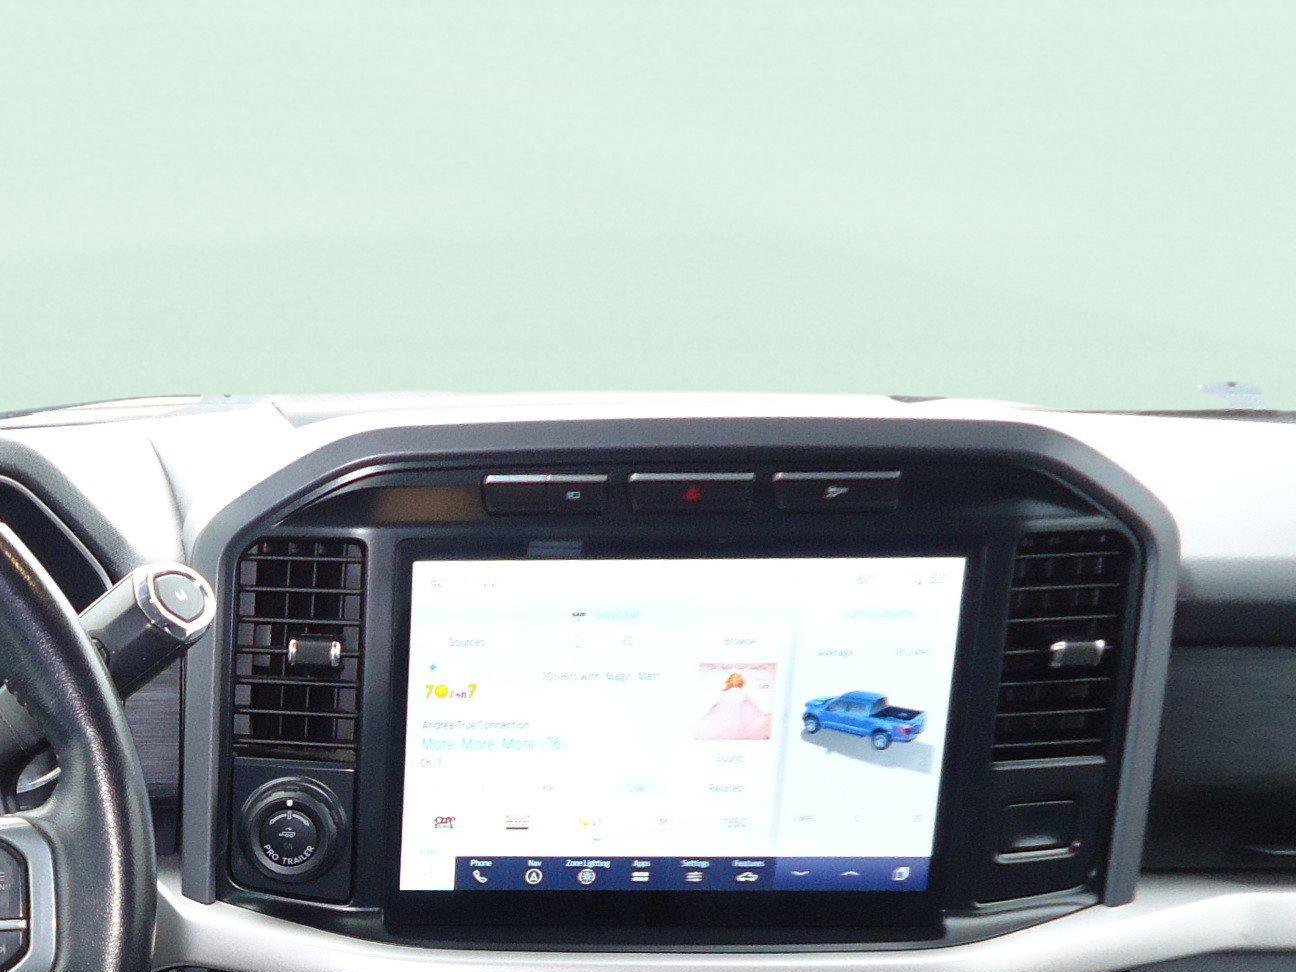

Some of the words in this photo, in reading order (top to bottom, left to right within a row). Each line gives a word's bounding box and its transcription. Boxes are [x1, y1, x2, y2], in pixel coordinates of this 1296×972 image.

[263, 844, 280, 861] PRO
[282, 845, 315, 865] TRAILER
[470, 859, 492, 867] Phone
[528, 859, 542, 867] Nav
[565, 859, 582, 867] Zone
[583, 859, 610, 869] Lighting
[633, 860, 651, 869] Apps
[680, 859, 710, 869] Settings
